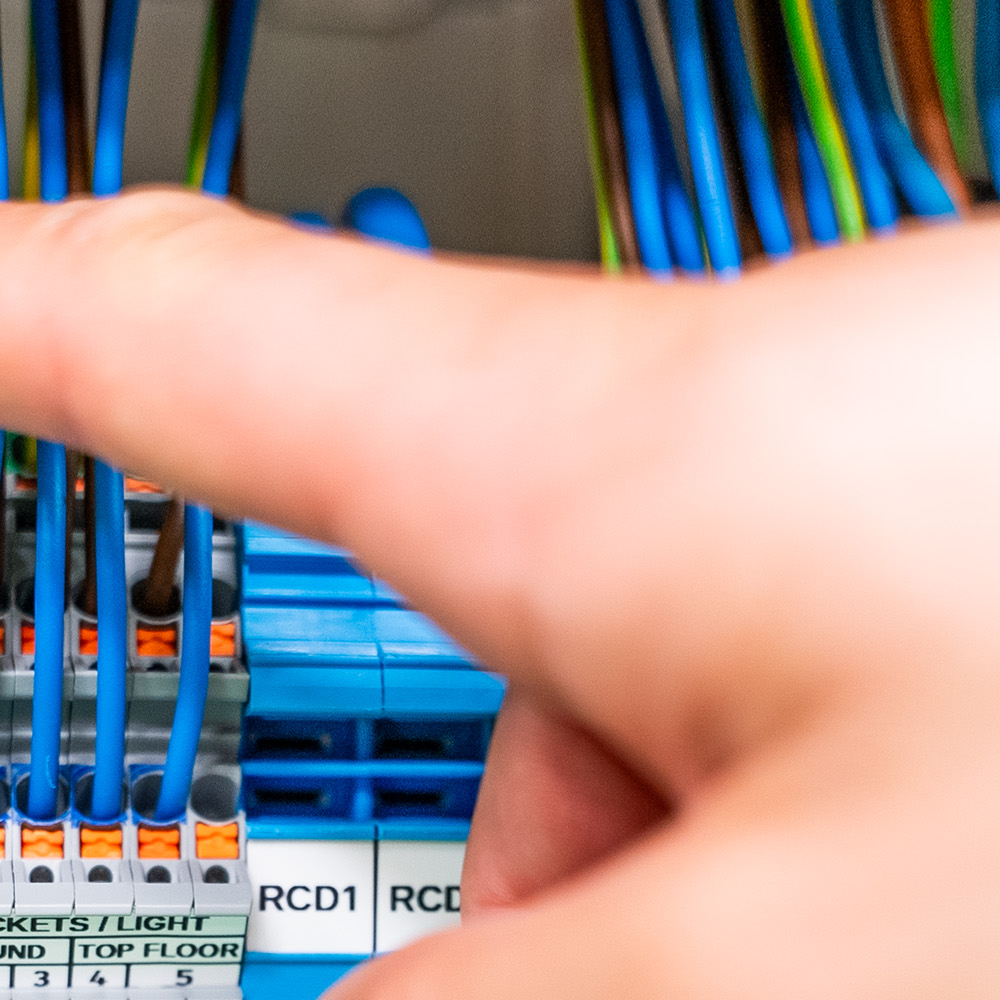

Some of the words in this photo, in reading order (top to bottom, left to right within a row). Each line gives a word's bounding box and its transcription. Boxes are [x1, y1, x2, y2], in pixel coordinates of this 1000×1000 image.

[259, 885, 356, 912] RCD1
[98, 916, 110, 933] /
[116, 916, 211, 932] LIGHT
[78, 943, 135, 959] TOP
[143, 943, 240, 959] FLOOR
[33, 970, 50, 987] 3
[89, 969, 106, 987] 4
[176, 969, 194, 987] 5
